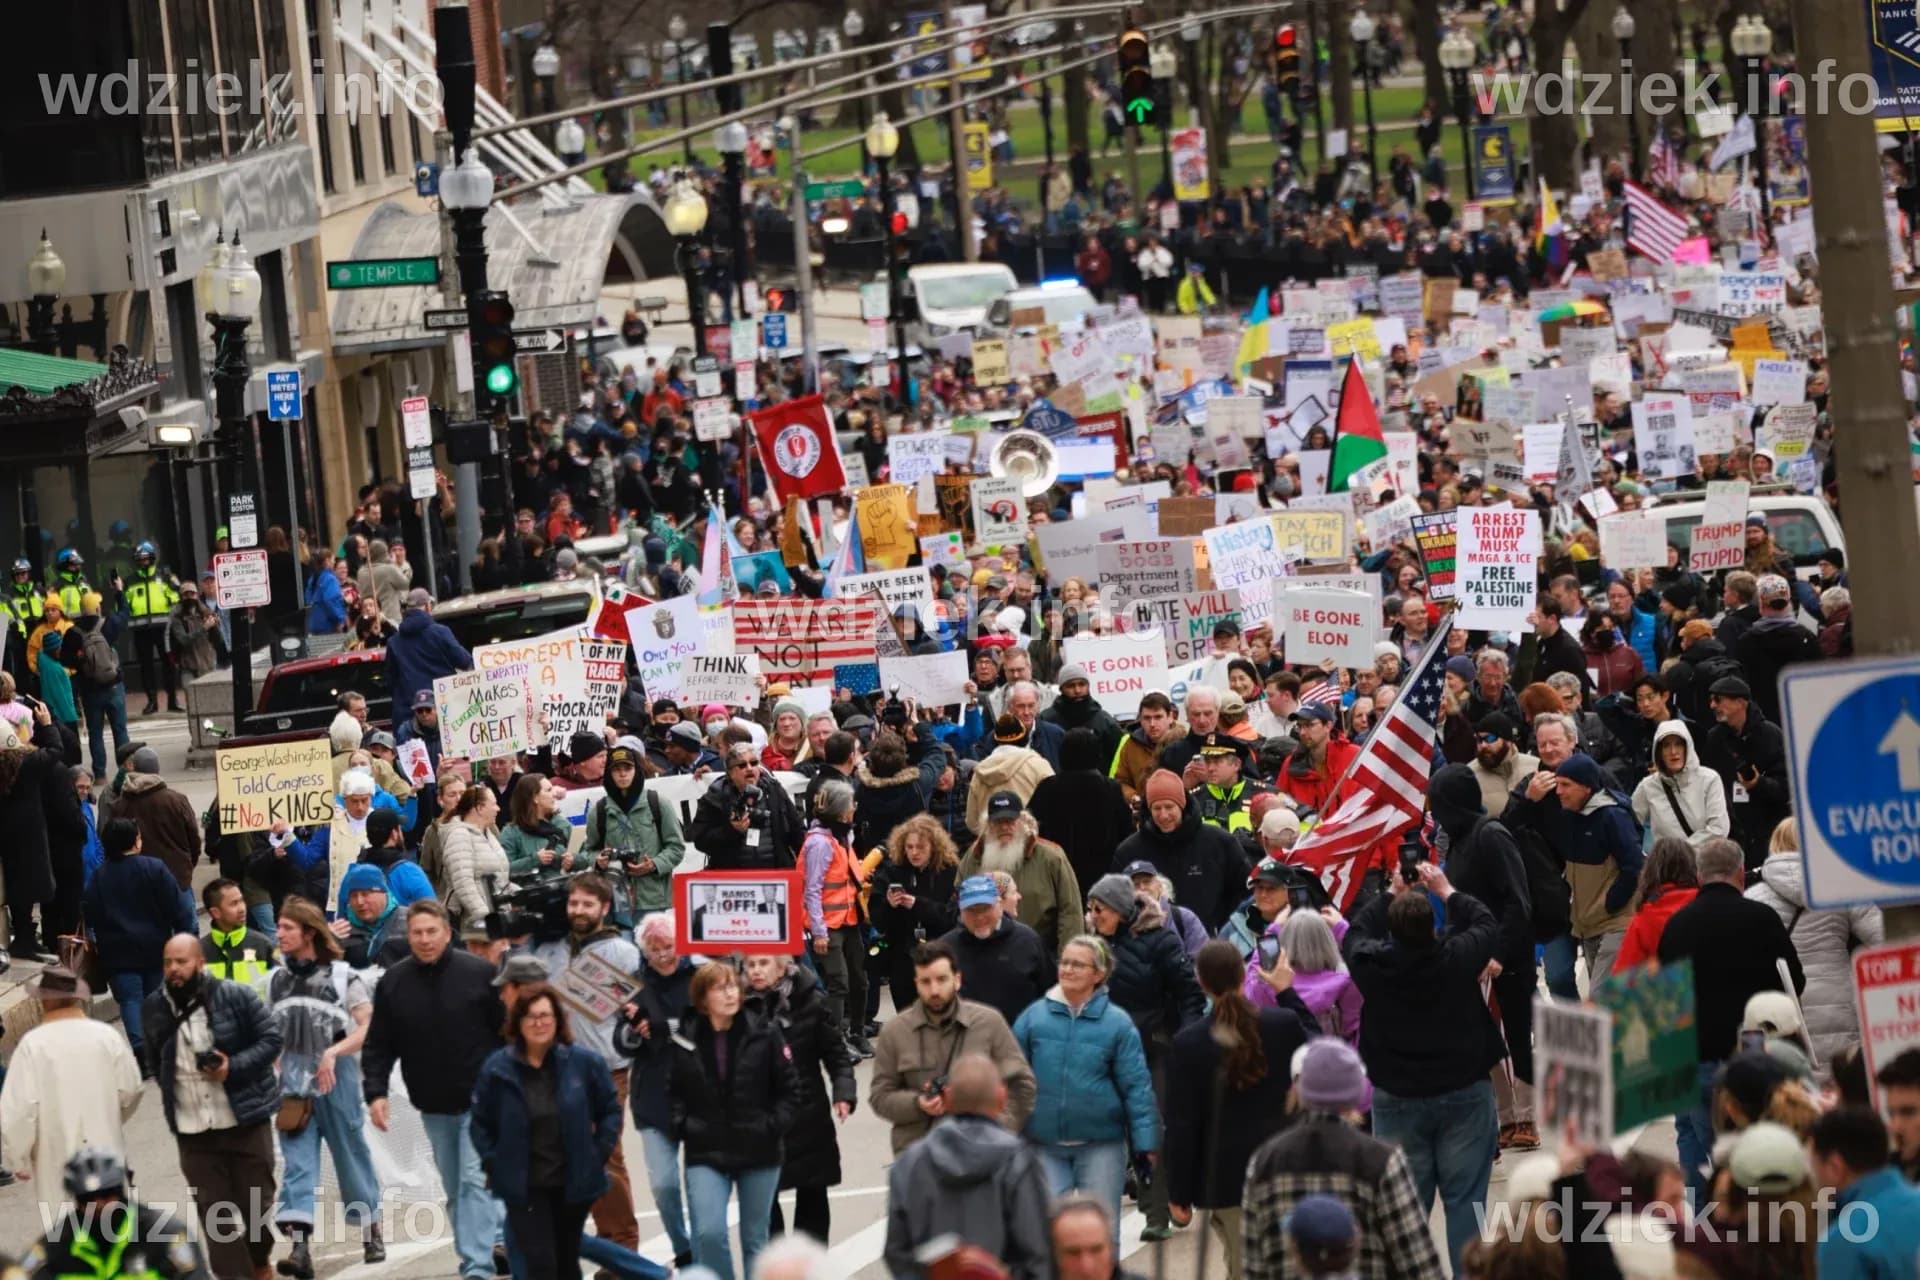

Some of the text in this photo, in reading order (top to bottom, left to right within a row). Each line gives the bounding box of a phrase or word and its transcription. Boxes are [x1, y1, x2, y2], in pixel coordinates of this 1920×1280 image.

[358, 265, 416, 282] TEMPLE
[453, 314, 469, 325] WA
[527, 336, 547, 348] WAY
[276, 374, 291, 383] PAY
[270, 383, 297, 392] METER
[274, 392, 295, 401] HERE
[1031, 410, 1061, 430] BTU
[409, 451, 431, 460] PARK
[230, 494, 254, 505] PARK
[231, 504, 255, 513] BOSTON
[1274, 516, 1339, 531] TAX THE
[1471, 513, 1527, 526] ARREST
[1475, 527, 1525, 539] TRUMP
[1693, 522, 1743, 541] TRUMP
[1119, 541, 1171, 554] STOP
[1212, 524, 1274, 556] History
[1422, 533, 1457, 549] UKRAIN
[1480, 540, 1519, 552] MUSK
[1120, 554, 1174, 568] DOGE
[1467, 553, 1531, 563] MAGA & ICE
[1690, 548, 1743, 570] STUPID
[1099, 568, 1179, 585] Department
[1482, 566, 1516, 580] FREE
[841, 574, 925, 593] WE HAVE SEEN
[1140, 581, 1180, 595] Greed
[1465, 580, 1533, 594] PALESTINE
[886, 590, 924, 603] ENEMY
[1475, 595, 1524, 607] & LUIGI
[1136, 599, 1181, 622] HATE
[1184, 593, 1234, 616] WILL
[1293, 609, 1310, 622] BE
[1307, 632, 1349, 647] ELON
[479, 640, 577, 669] CONCEPT
[589, 645, 623, 660] OF MY
[643, 641, 697, 663] ONLY YOU
[753, 640, 819, 668] NOT
[587, 664, 621, 680] RAGE
[692, 655, 748, 674] THINK
[1077, 660, 1097, 675] BE
[453, 662, 529, 689] EQUITY EMPATHY
[641, 666, 664, 682] CAN
[687, 675, 721, 688] BEFORE
[590, 682, 619, 695] FIT ON
[1097, 677, 1144, 694] ELON
[696, 690, 737, 702] ILLEGAL
[479, 703, 498, 718] US
[543, 700, 606, 718] EMOCRACY
[548, 720, 590, 734] DIES IN
[220, 745, 329, 772] George Washington
[232, 774, 324, 797] Told Congress
[268, 790, 335, 825] KINGS
[1827, 800, 1920, 838] EVACU
[721, 890, 756, 898] HANDS
[722, 899, 757, 912] OFF!
[1861, 957, 1902, 984] TOW
[1897, 994, 1920, 1017] N
[1872, 1019, 1920, 1043] STOP
